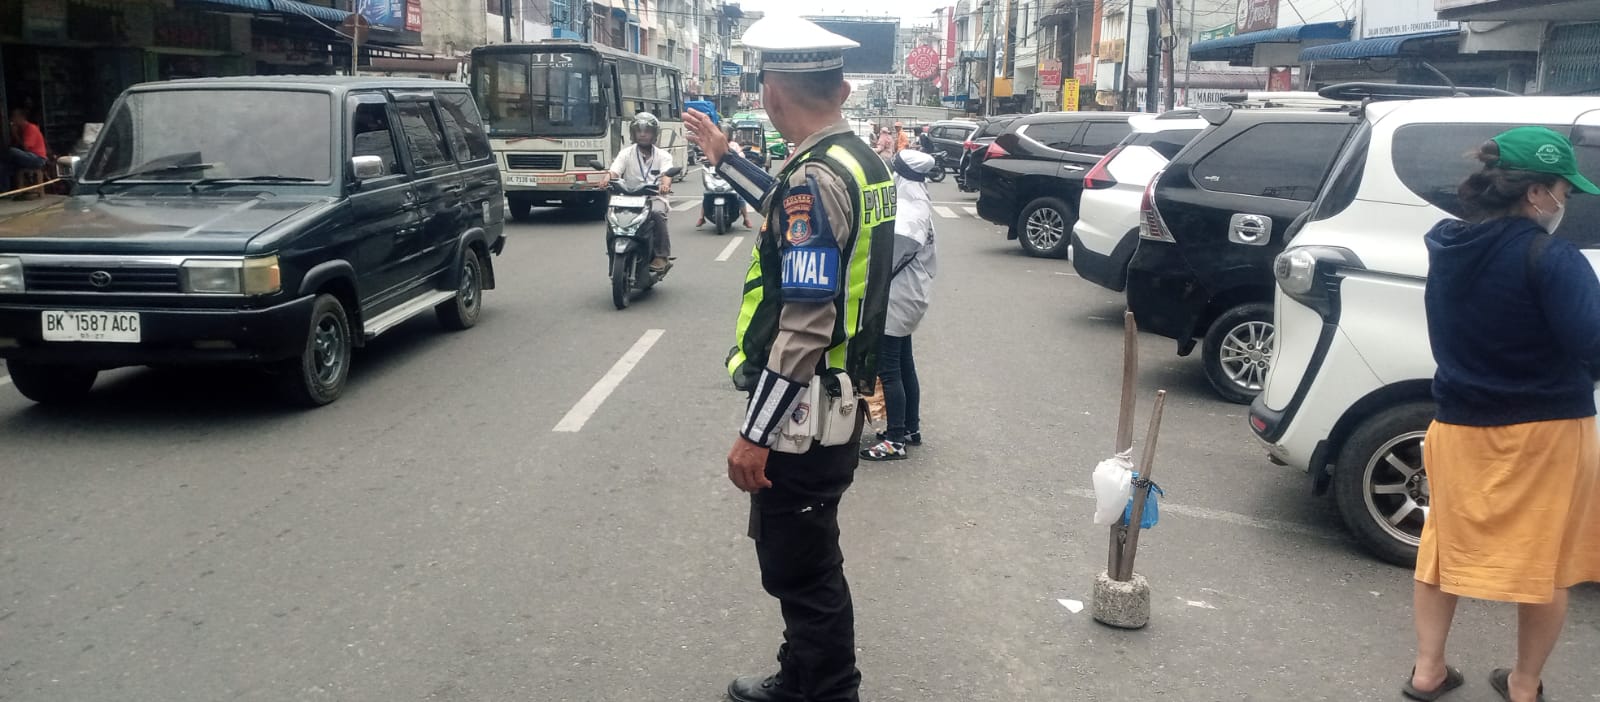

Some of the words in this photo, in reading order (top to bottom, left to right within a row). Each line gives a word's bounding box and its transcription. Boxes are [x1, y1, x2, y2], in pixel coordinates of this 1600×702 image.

[911, 47, 935, 58] OPTIK
[781, 251, 829, 285] TWAL
[47, 314, 64, 331] BK
[75, 314, 108, 332] 1587
[112, 315, 137, 332] ACC
